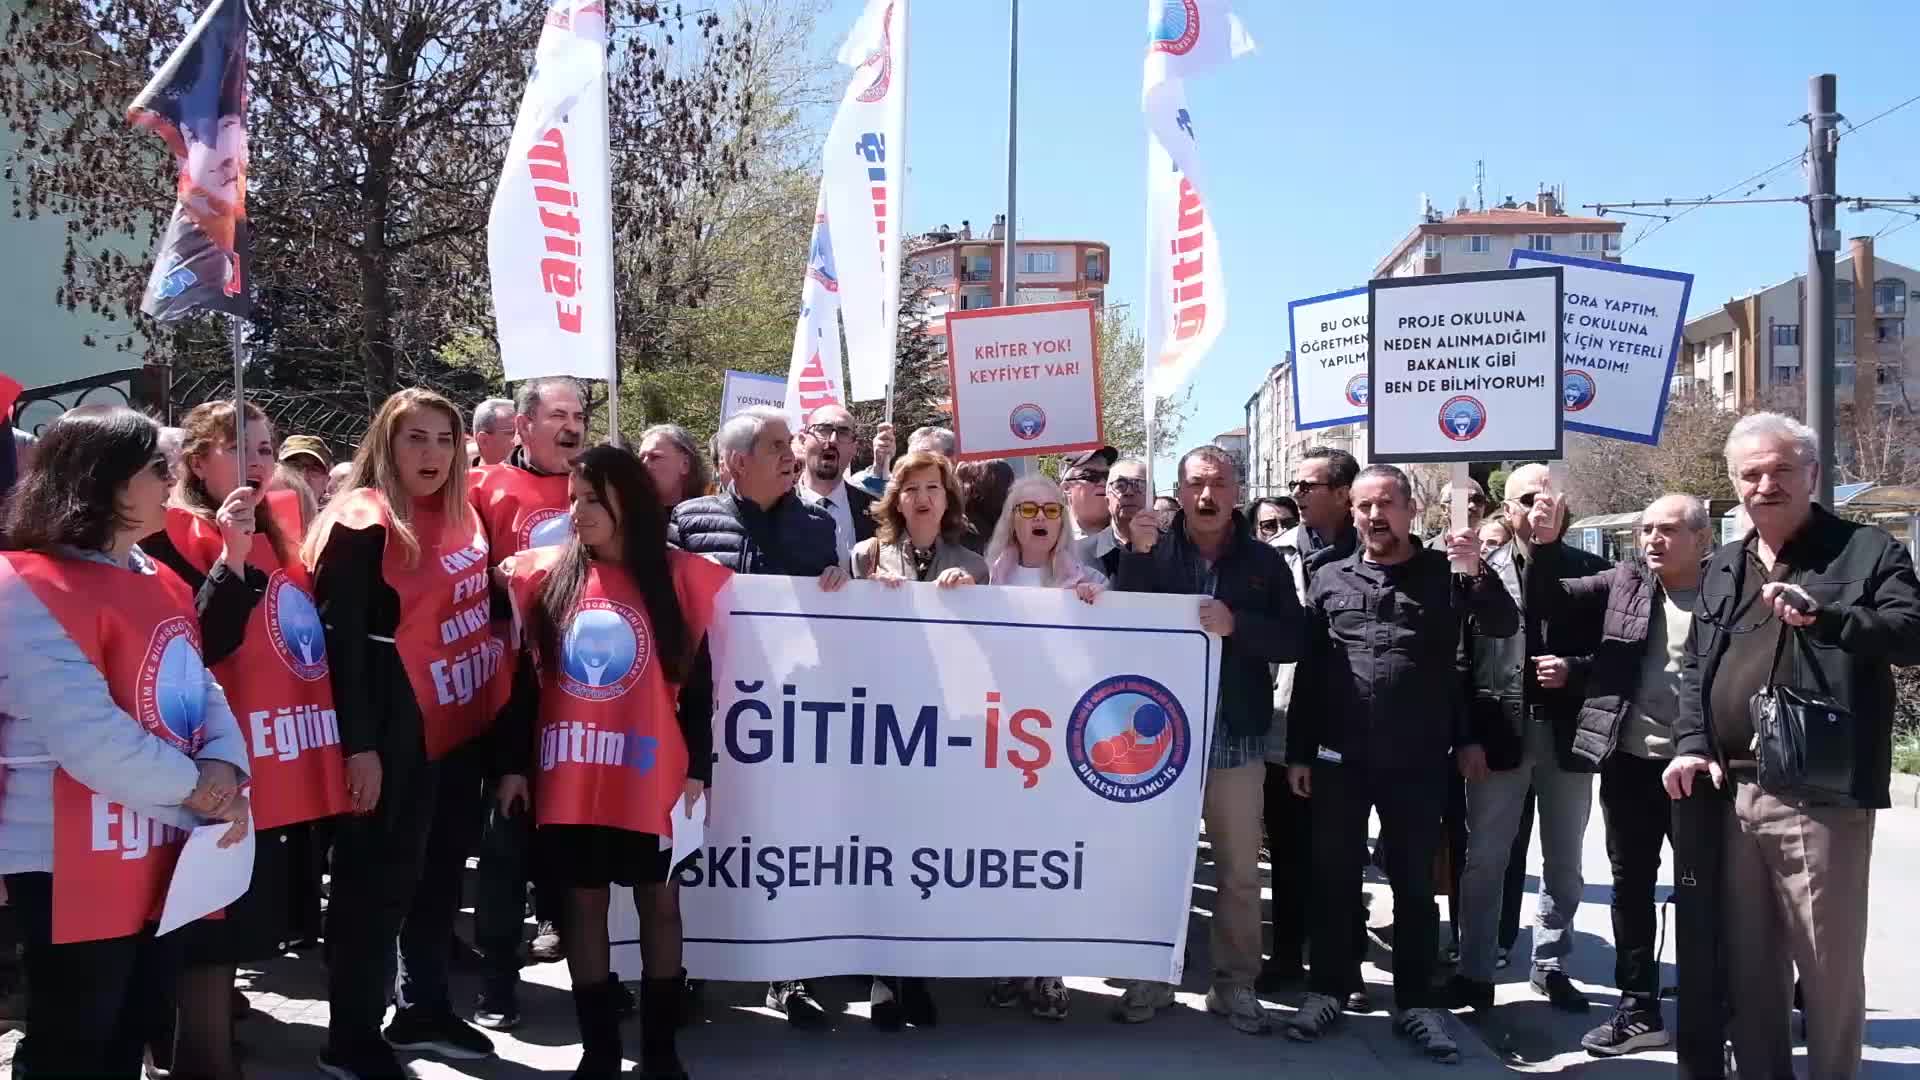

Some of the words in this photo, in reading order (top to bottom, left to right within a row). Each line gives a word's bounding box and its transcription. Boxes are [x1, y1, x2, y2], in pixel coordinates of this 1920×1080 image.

[1160, 176, 1206, 362] ğitim
[1604, 298, 1659, 318] YAPTIM.
[1320, 320, 1337, 333] BU
[1399, 314, 1445, 329] PROJE
[1450, 310, 1526, 326] OKULUNA
[1579, 315, 1648, 336] OKULUNA
[975, 341, 1027, 360] KRİTER
[1032, 338, 1072, 355] YOK!
[1384, 337, 1431, 351] NEDEN
[1437, 329, 1546, 348] ALINMADIĞIMI
[1575, 331, 1604, 350] İÇİN
[1609, 339, 1664, 359] YETERLİ
[1407, 356, 1480, 371] BAKANLIK
[1485, 351, 1516, 368] GİBİ
[969, 364, 1040, 384] KEYFİYET
[1044, 361, 1080, 377] VAR!
[1385, 381, 1412, 394] BEN
[1417, 379, 1436, 393] DE
[1441, 374, 1545, 392] BİLMİYORUM!
[712, 679, 1053, 789] ĞİTİM-İŞ
[1078, 763, 1127, 798] BİRLEŞİK
[1129, 765, 1177, 798] KAMU-İŞ
[910, 840, 1085, 900] ŞUBESİ
